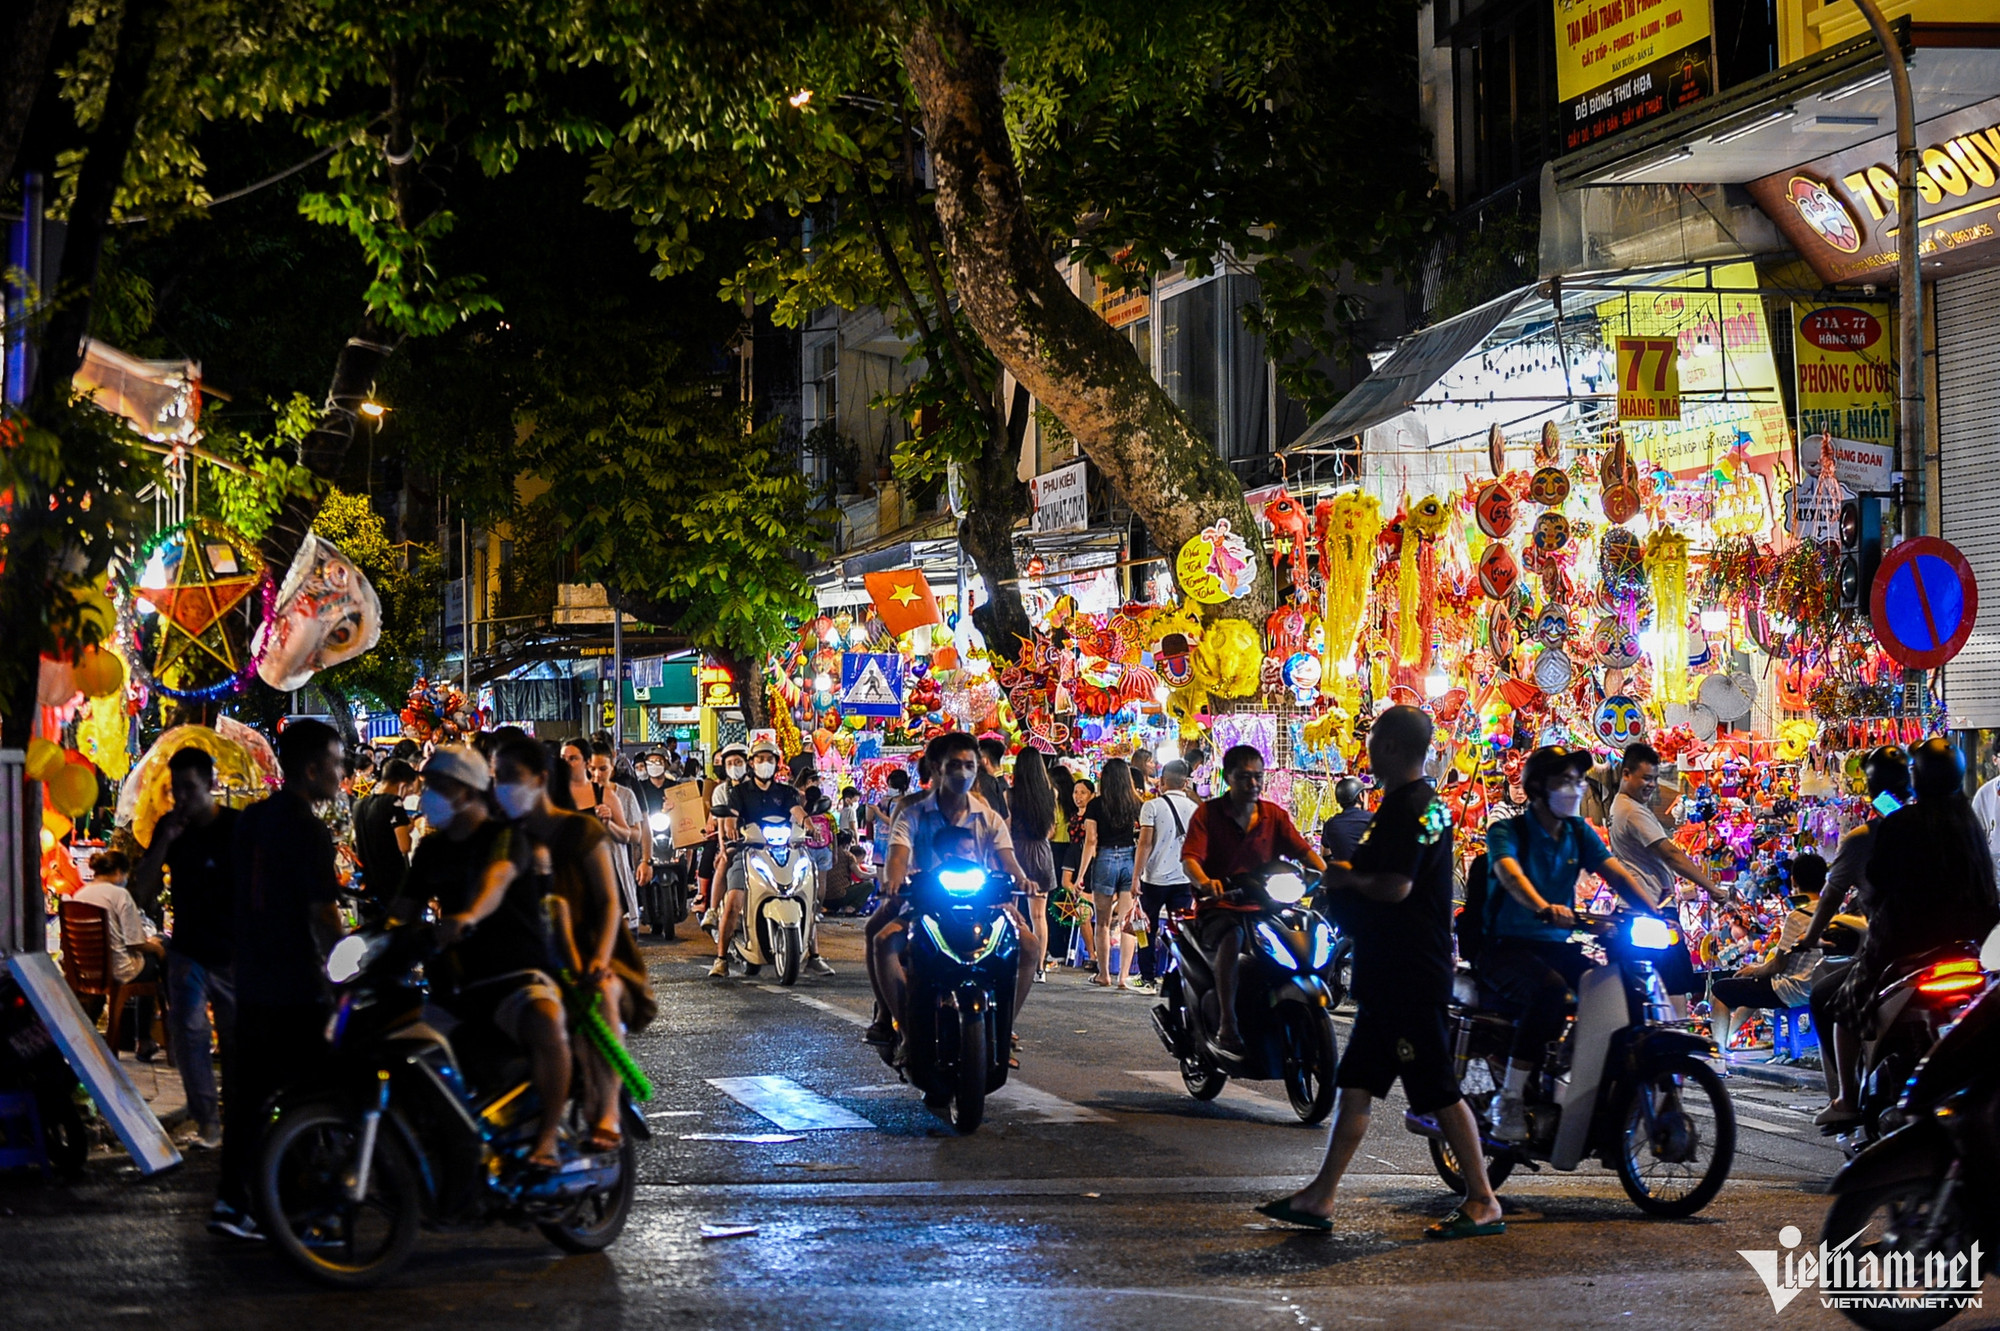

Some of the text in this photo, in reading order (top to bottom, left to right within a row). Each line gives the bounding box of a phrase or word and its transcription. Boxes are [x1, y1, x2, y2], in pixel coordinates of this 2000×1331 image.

[1815, 317, 1839, 329] 71A
[1853, 317, 1867, 329] 77
[1819, 332, 1848, 345] HÀNG
[1620, 341, 1673, 391] 77
[1799, 354, 1850, 394] PHÔNG
[1620, 395, 1679, 416] HÀNG MÃ
[1802, 402, 1890, 444] SINH NHẬT
[1042, 472, 1076, 494] PHỤ KIỆN
